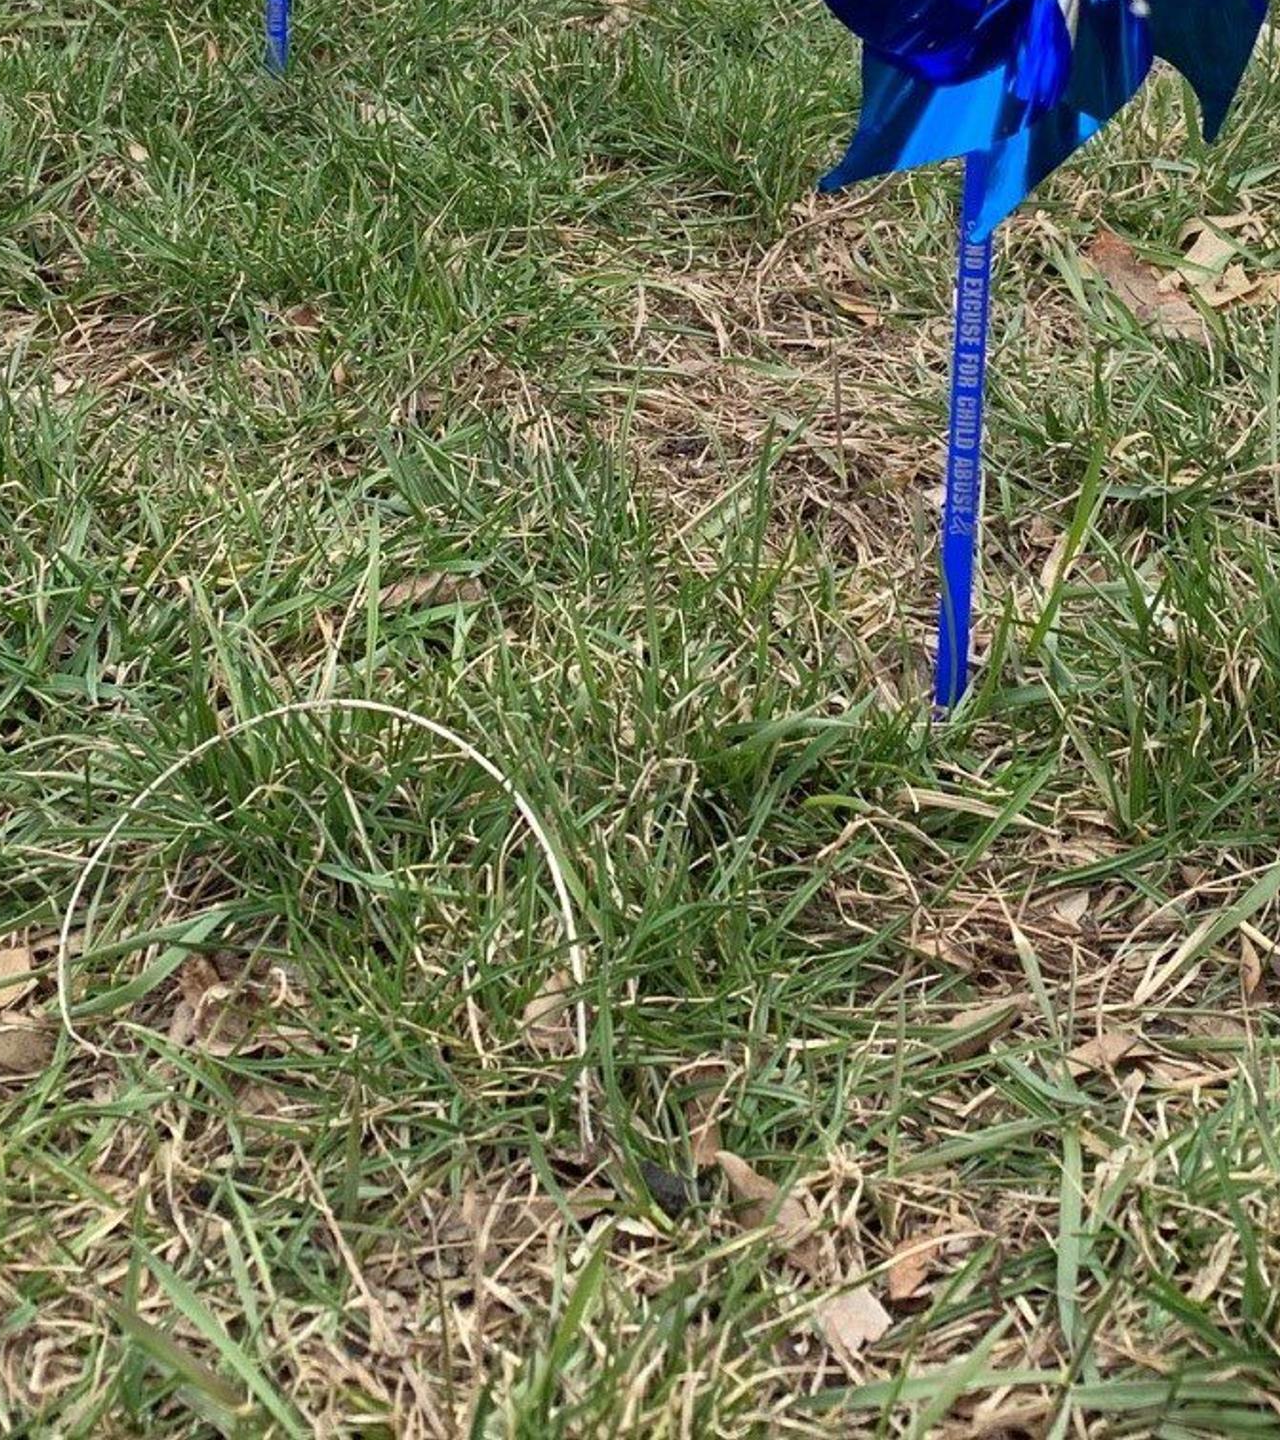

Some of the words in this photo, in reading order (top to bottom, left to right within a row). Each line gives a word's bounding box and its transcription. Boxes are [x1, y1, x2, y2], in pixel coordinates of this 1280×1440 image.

[964, 244, 986, 271] NO
[959, 277, 983, 345] EXCUSE
[958, 353, 979, 388] FOR
[954, 396, 977, 450] CHILD
[951, 455, 974, 515] ABUSE
